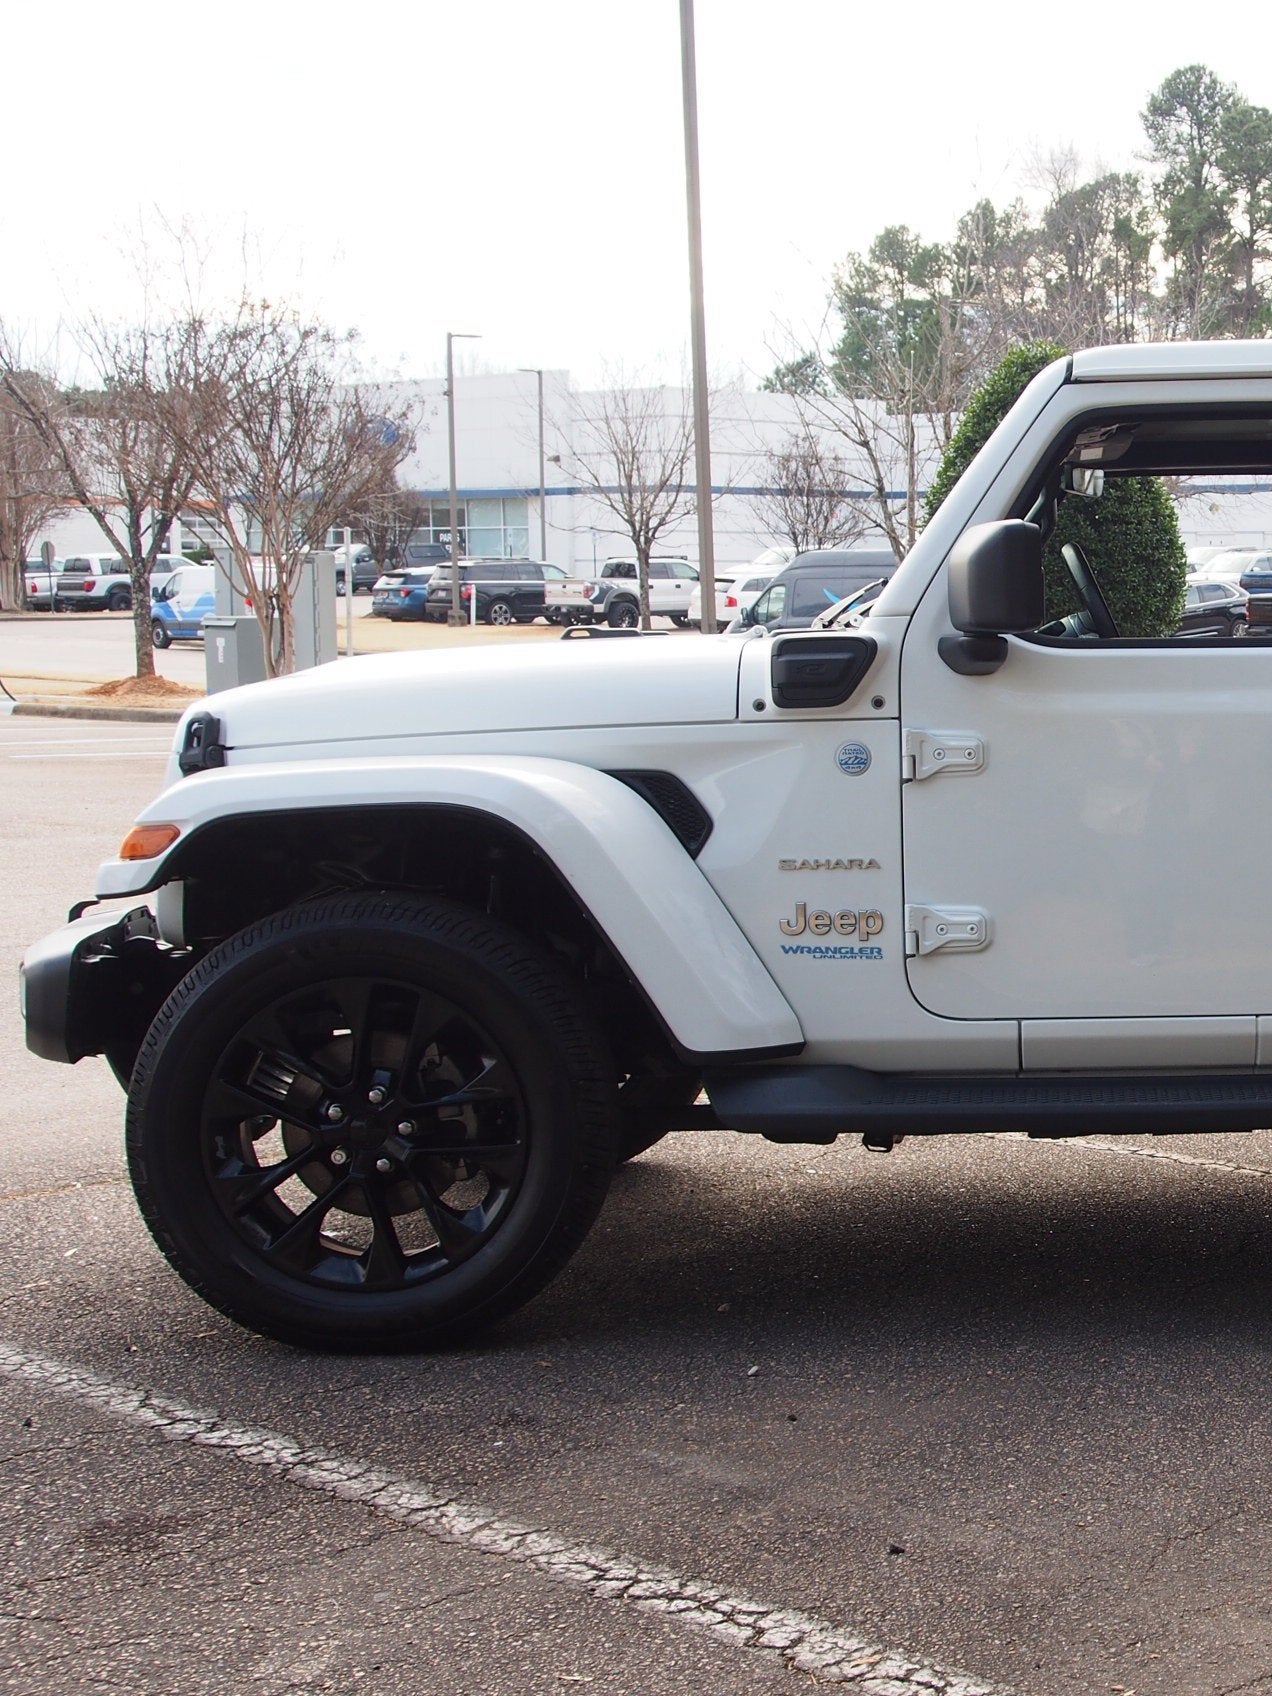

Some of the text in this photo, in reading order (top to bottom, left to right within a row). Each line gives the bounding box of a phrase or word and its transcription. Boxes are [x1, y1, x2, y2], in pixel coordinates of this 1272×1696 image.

[439, 533, 460, 542] PARS
[778, 858, 881, 870] SAHARA
[779, 901, 884, 941] Jeep
[780, 945, 883, 955] WRANGLER
